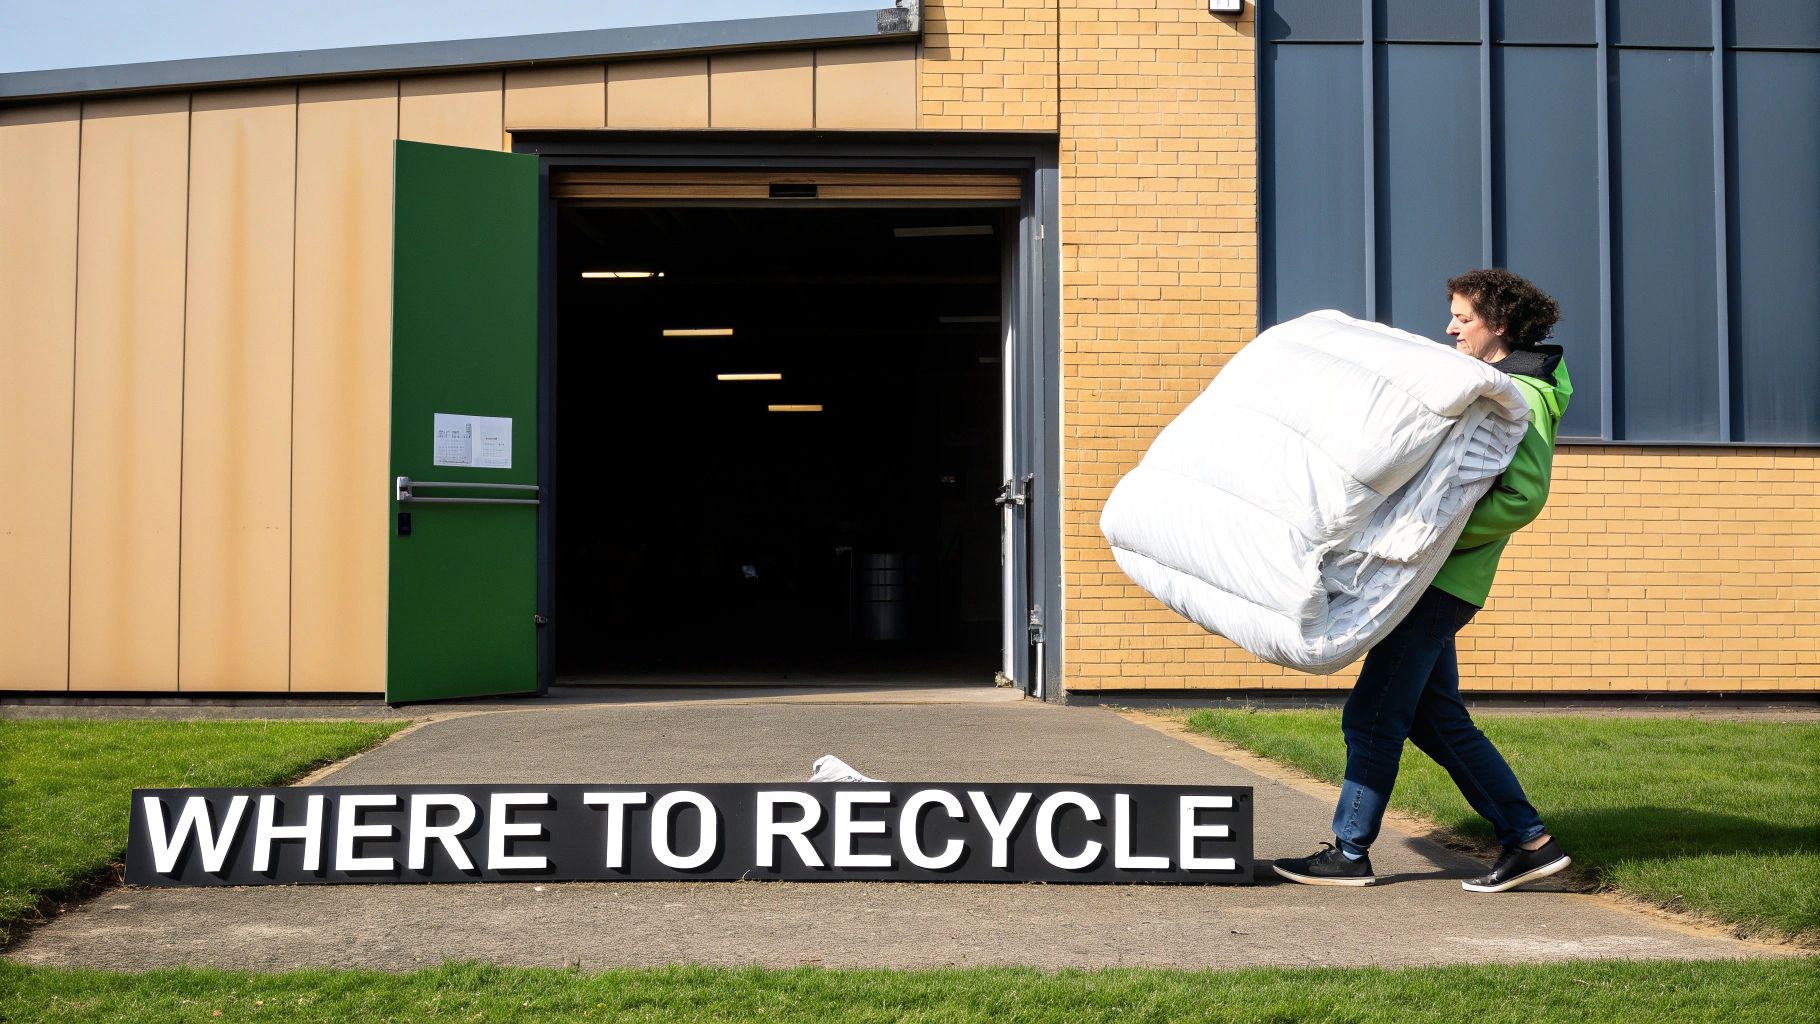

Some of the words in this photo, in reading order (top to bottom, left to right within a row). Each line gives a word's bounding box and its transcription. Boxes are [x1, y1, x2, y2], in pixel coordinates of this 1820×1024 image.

[143, 793, 548, 873] WHERE
[583, 790, 717, 869] TO
[756, 789, 1236, 870] RECYCLE
